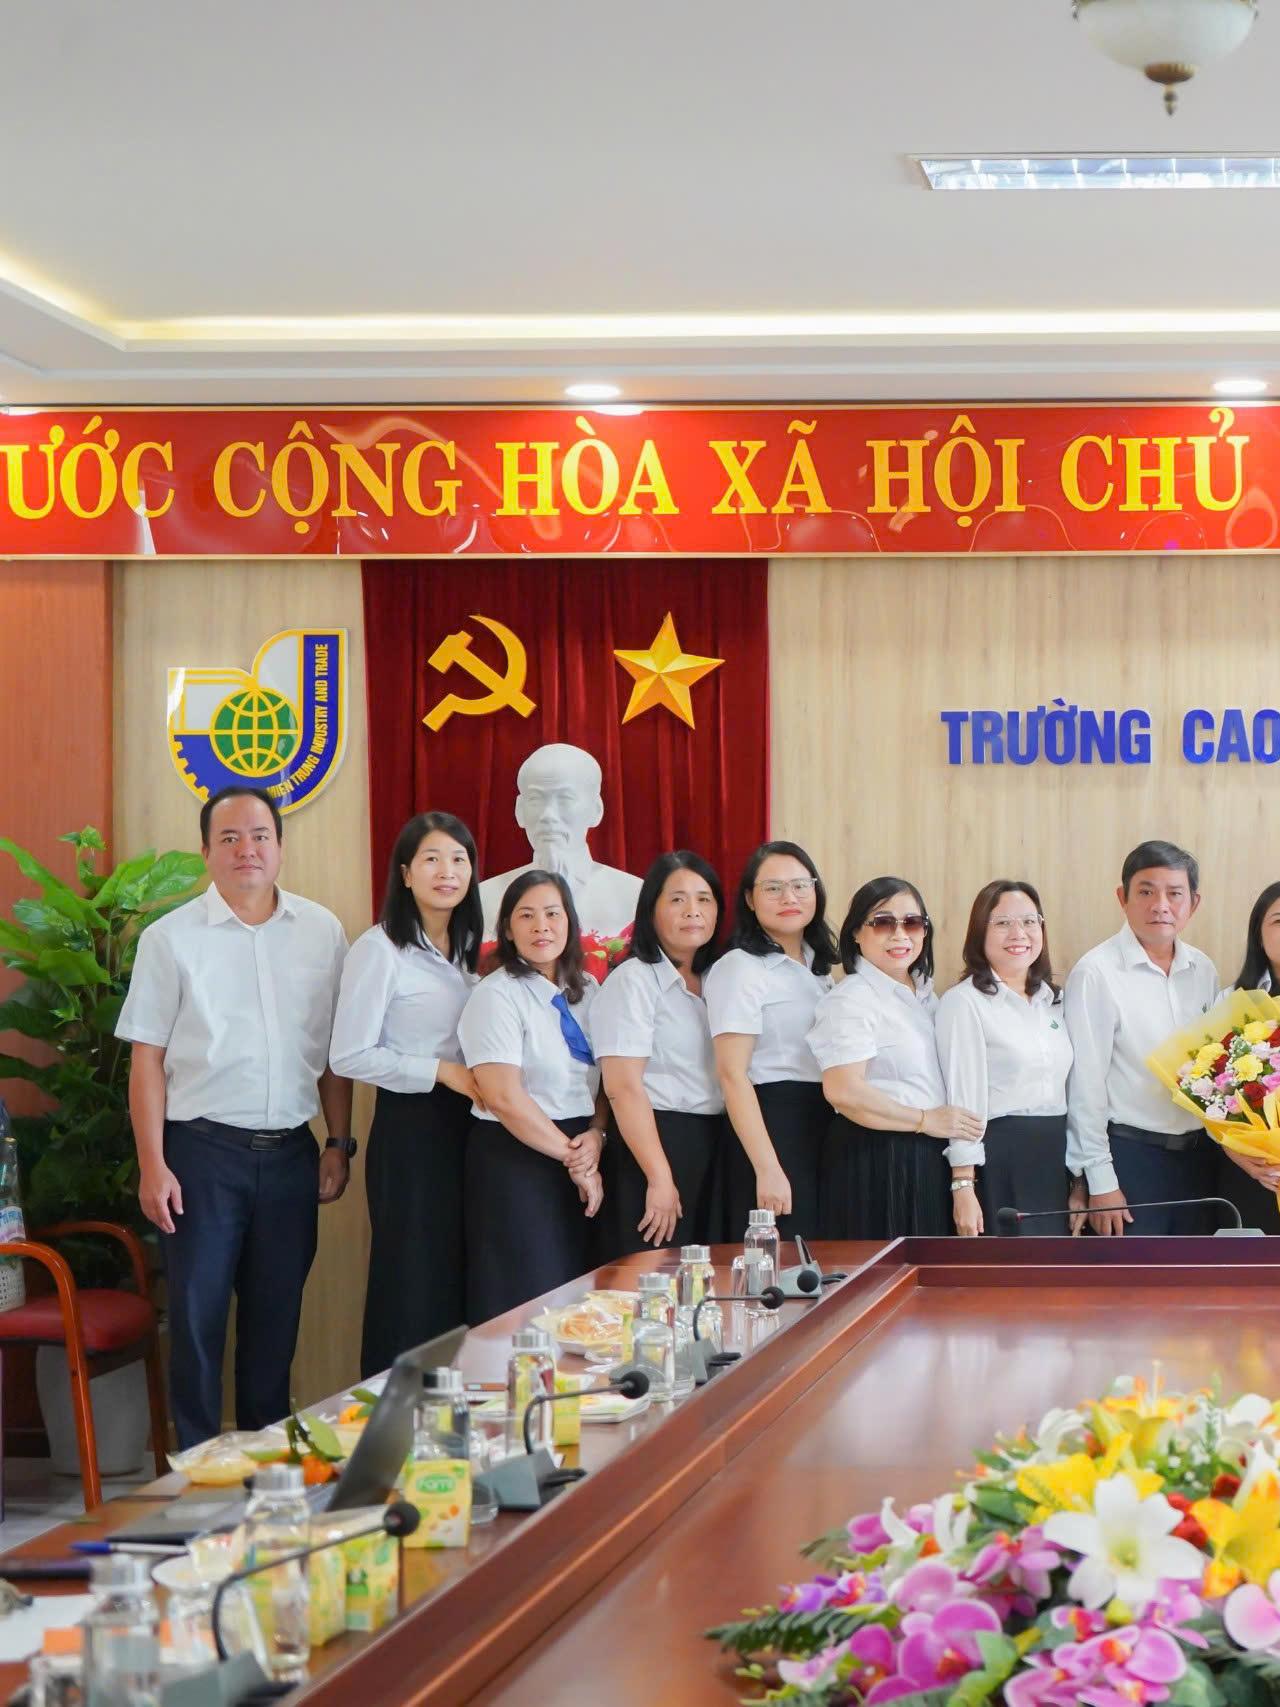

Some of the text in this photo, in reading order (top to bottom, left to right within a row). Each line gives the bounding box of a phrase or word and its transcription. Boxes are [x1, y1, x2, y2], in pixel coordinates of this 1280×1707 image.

[0, 415, 175, 520] ƯỚC
[213, 421, 462, 533] CỘNG
[495, 415, 680, 516] HÒA
[710, 420, 832, 515] XÃ
[867, 415, 1026, 527] HỘI
[1060, 407, 1250, 512] CHỦ
[314, 643, 329, 677] TRADE
[314, 680, 329, 703] AND
[311, 705, 329, 755] INDUSTRY
[940, 697, 1152, 765] TRƯỜNG
[292, 755, 322, 786] TRUNG
